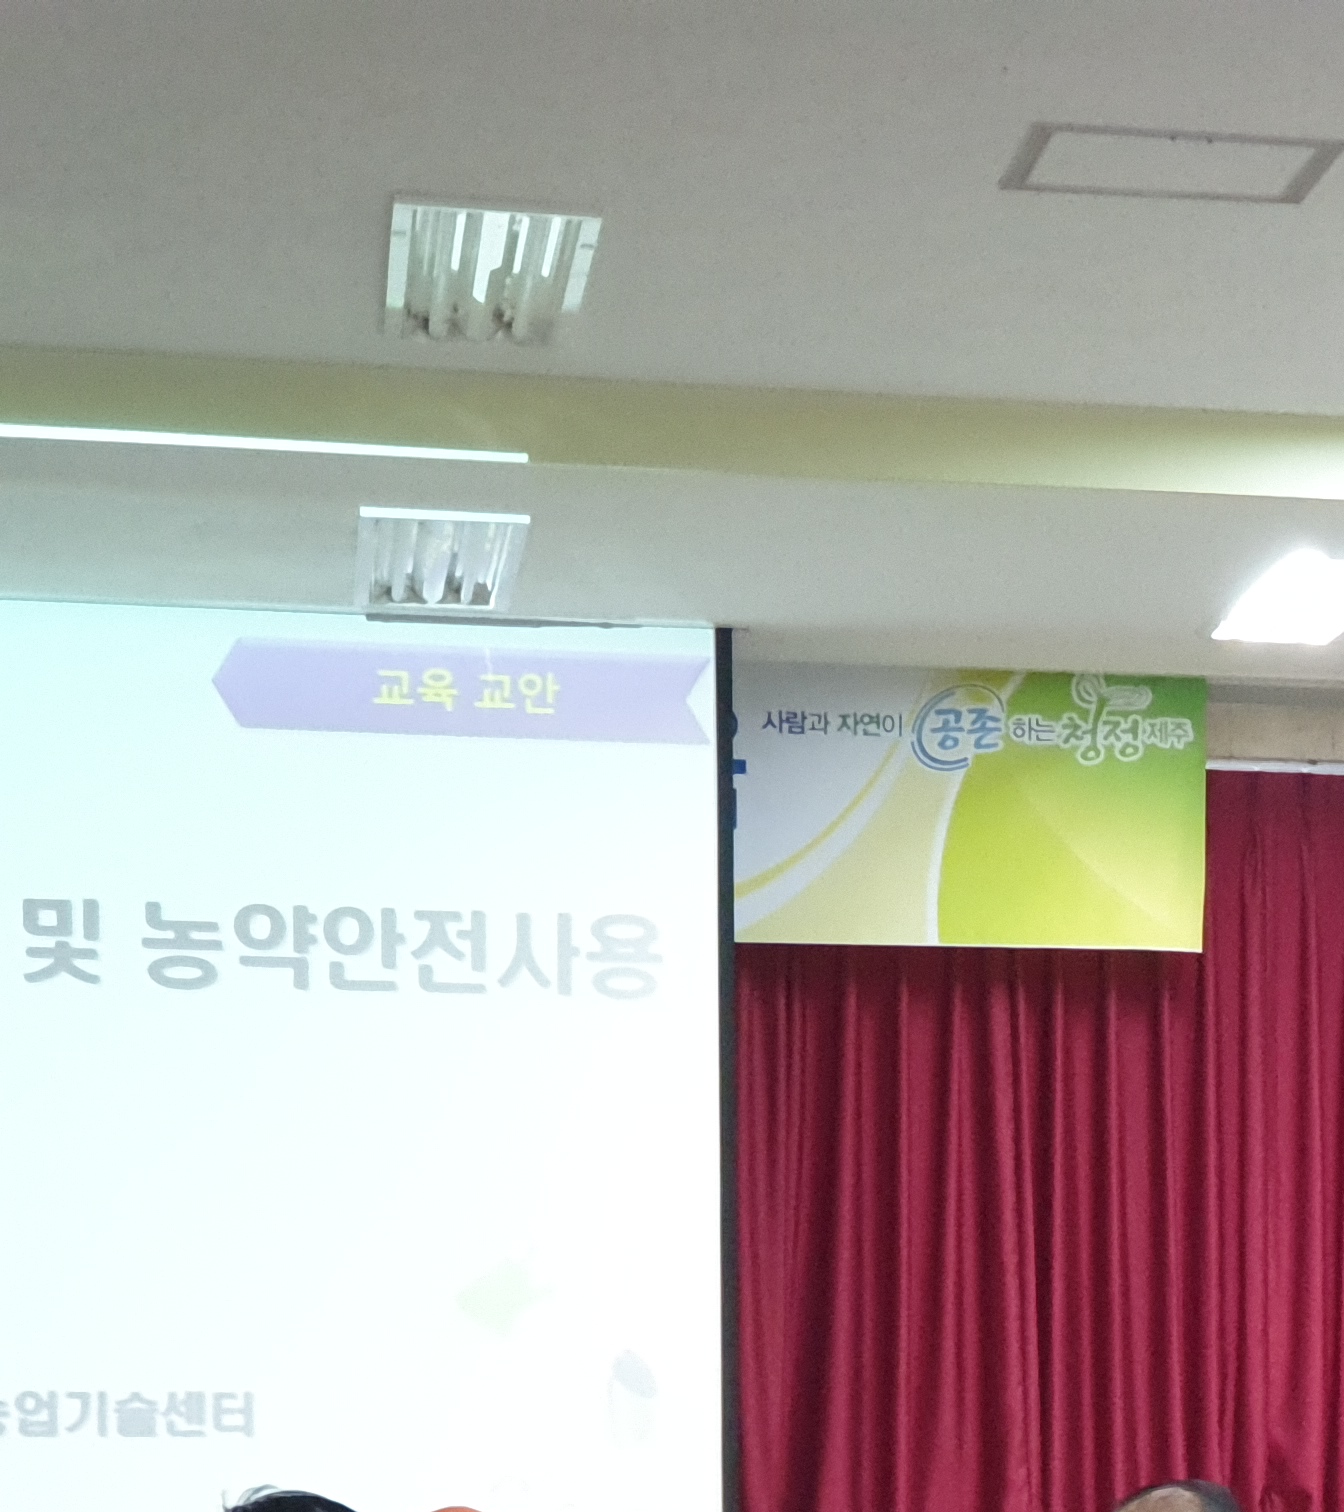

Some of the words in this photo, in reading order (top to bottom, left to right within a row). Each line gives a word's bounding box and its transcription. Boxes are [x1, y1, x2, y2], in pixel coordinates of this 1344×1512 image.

[372, 667, 458, 712] 교육
[473, 671, 560, 714] 교안
[762, 709, 829, 735] 사람과
[836, 712, 902, 738] 자연이
[21, 897, 101, 985] 및
[140, 900, 663, 1000] 농약안전사용
[0, 1391, 255, 1438] 업기술센터
